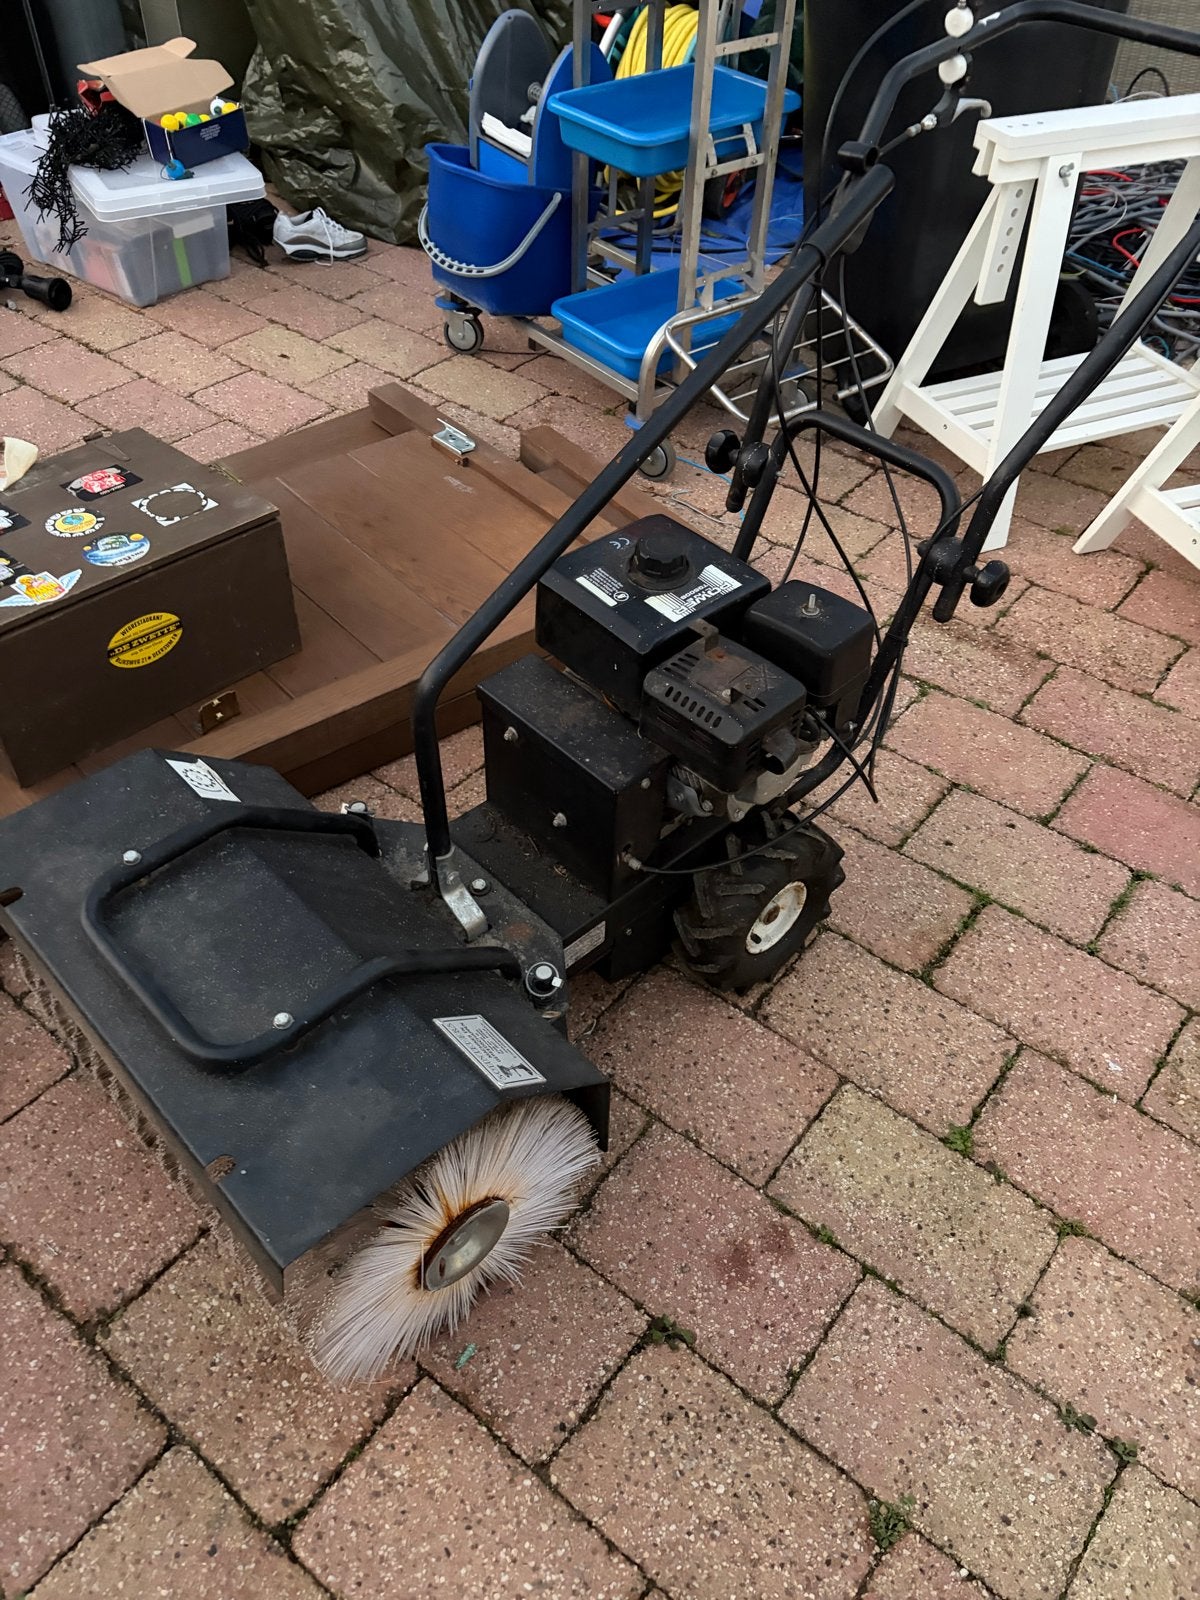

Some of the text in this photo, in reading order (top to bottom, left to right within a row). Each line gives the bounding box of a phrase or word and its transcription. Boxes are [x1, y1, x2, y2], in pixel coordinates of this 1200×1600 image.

[672, 580, 732, 615] POWER
[684, 587, 712, 603] LINE
[121, 615, 163, 636] WEGRESTAURANT
